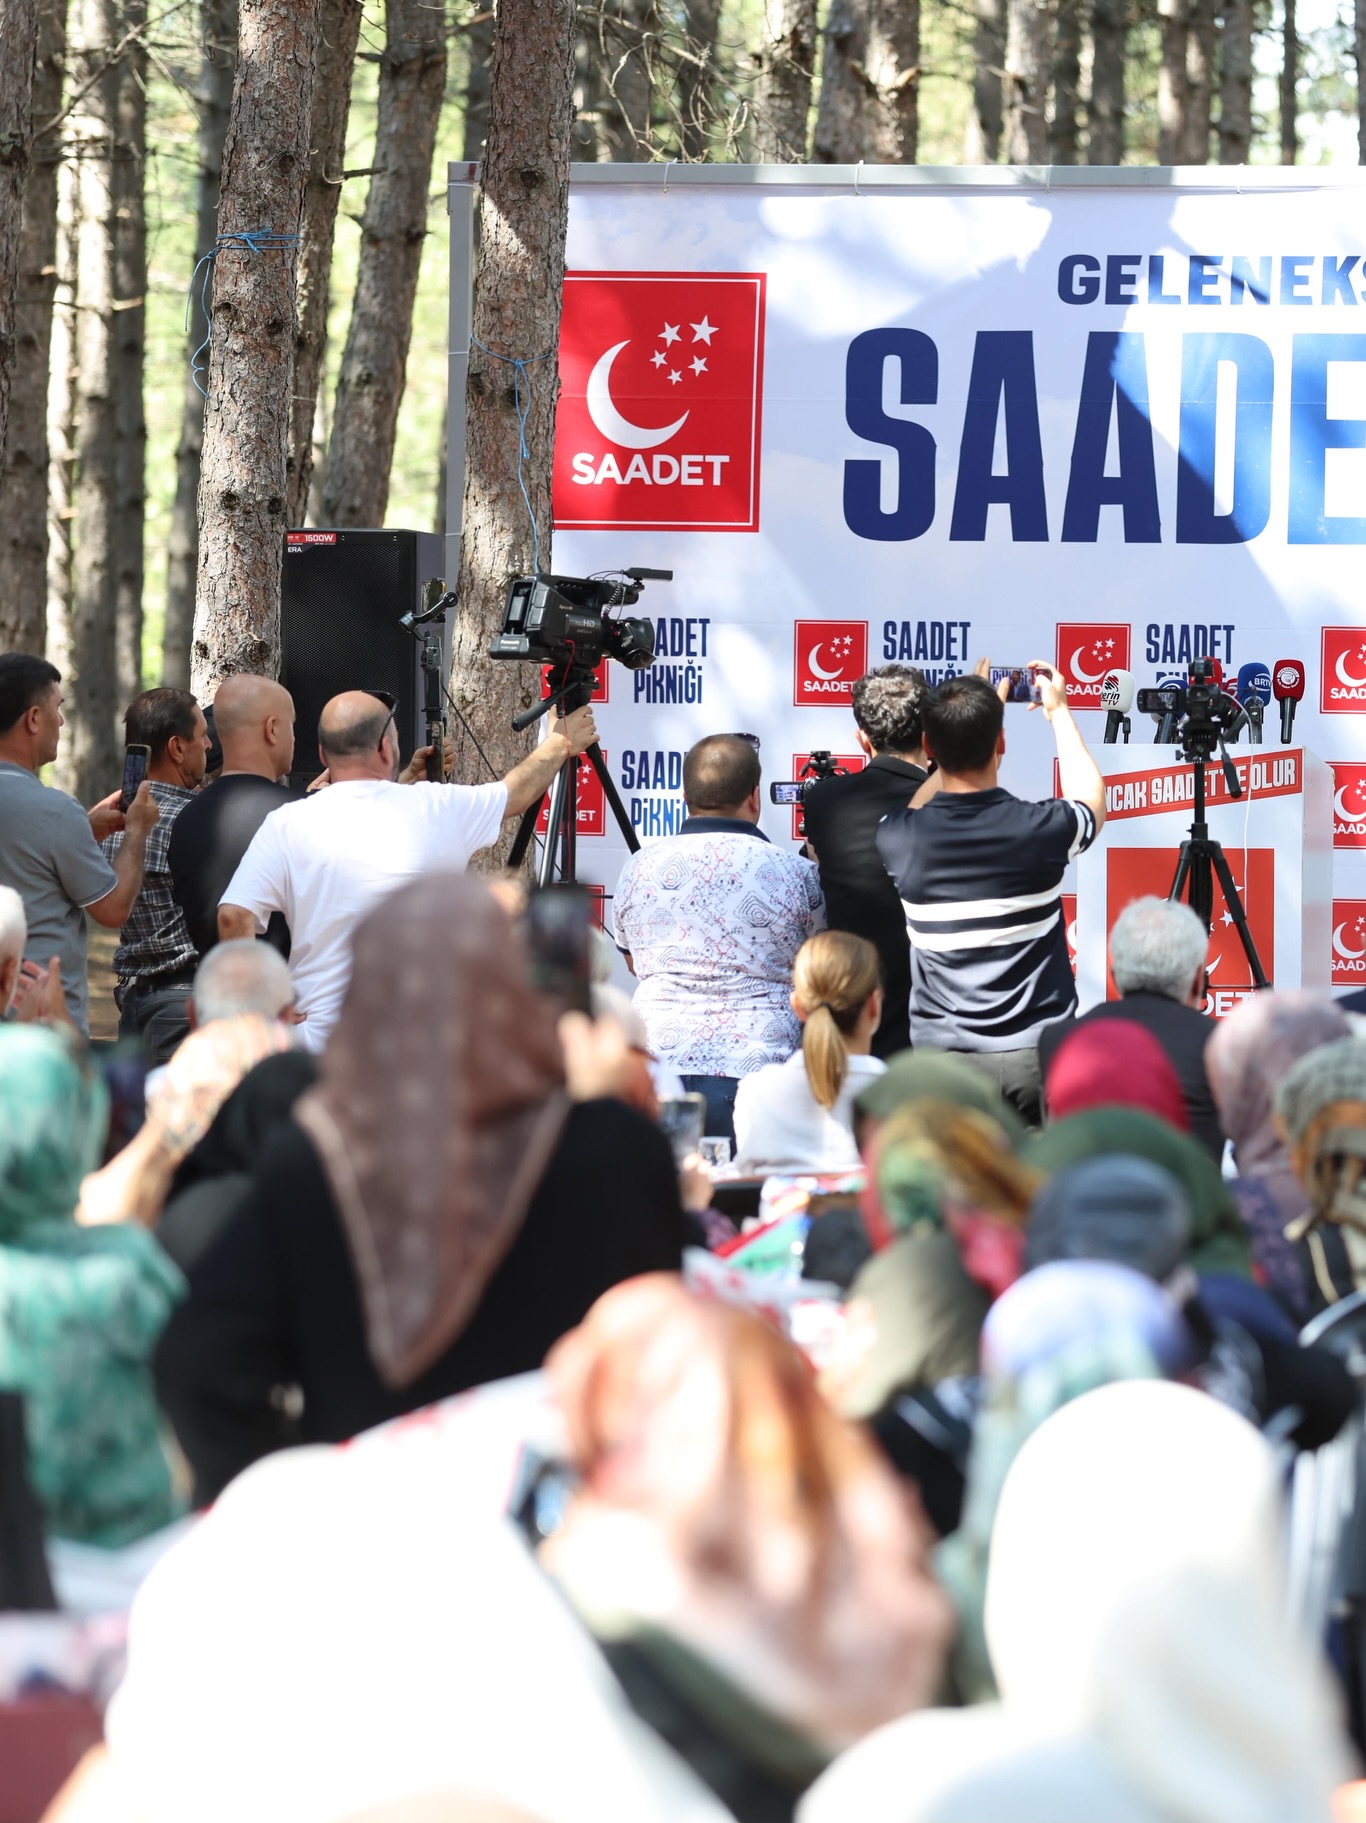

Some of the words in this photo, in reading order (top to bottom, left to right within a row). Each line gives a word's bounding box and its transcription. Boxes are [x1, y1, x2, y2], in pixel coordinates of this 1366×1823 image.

[571, 452, 730, 487] SAADET
[305, 534, 333, 542] 1500W
[654, 618, 710, 657] ADET
[883, 621, 971, 661] SAADET
[1146, 623, 1235, 664] SAADET
[1066, 683, 1102, 696] SAAD
[1101, 691, 1120, 701] erin
[622, 750, 684, 790] SAAD
[1104, 781, 1147, 812] NCAK
[1250, 758, 1296, 791] OLUR
